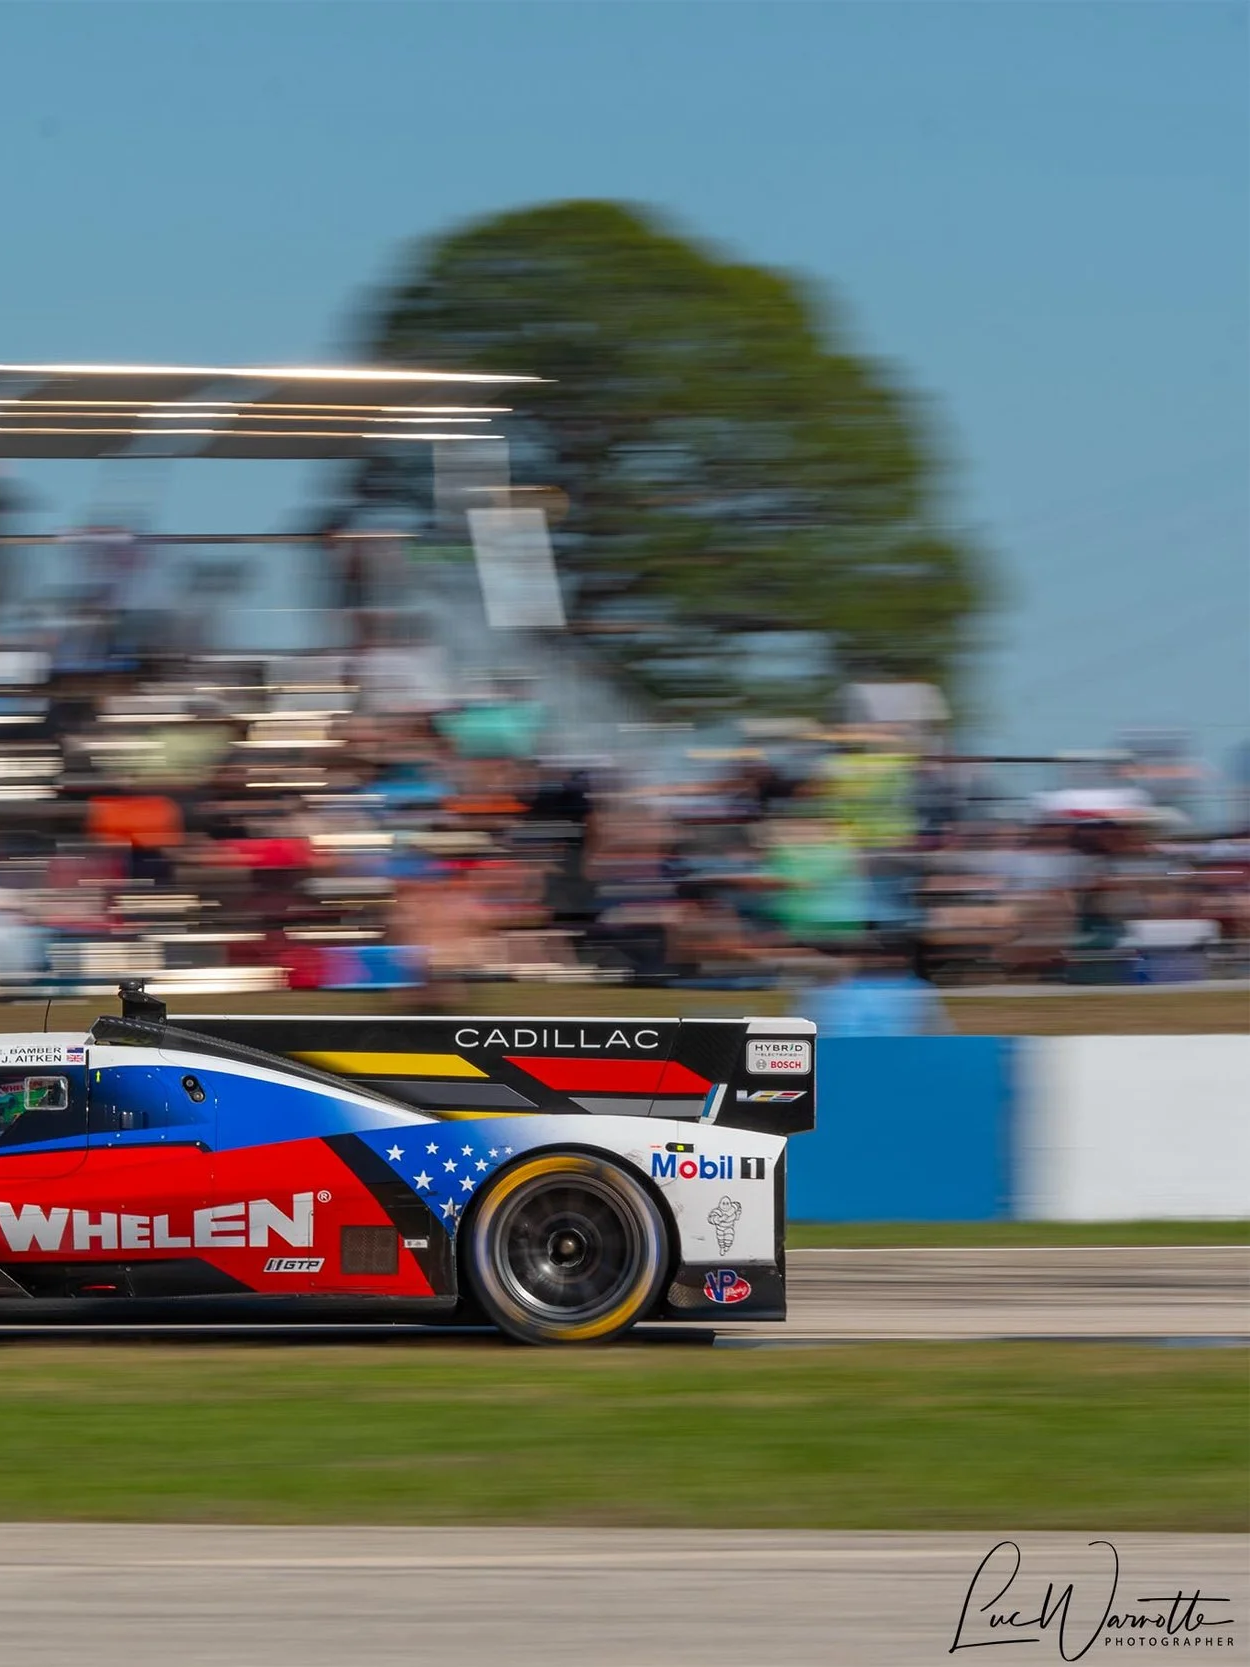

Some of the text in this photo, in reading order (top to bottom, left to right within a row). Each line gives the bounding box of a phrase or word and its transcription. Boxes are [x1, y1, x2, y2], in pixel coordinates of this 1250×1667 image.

[454, 1028, 659, 1049] CADILLAC
[10, 1047, 62, 1055] BAMBER
[755, 1044, 803, 1052] HYBRID
[15, 1054, 62, 1063] AITKEN
[770, 1061, 802, 1069] BOSCH
[652, 1153, 758, 1179] Mobil 1
[283, 1260, 320, 1270] GTP
[705, 1269, 738, 1302] VP
